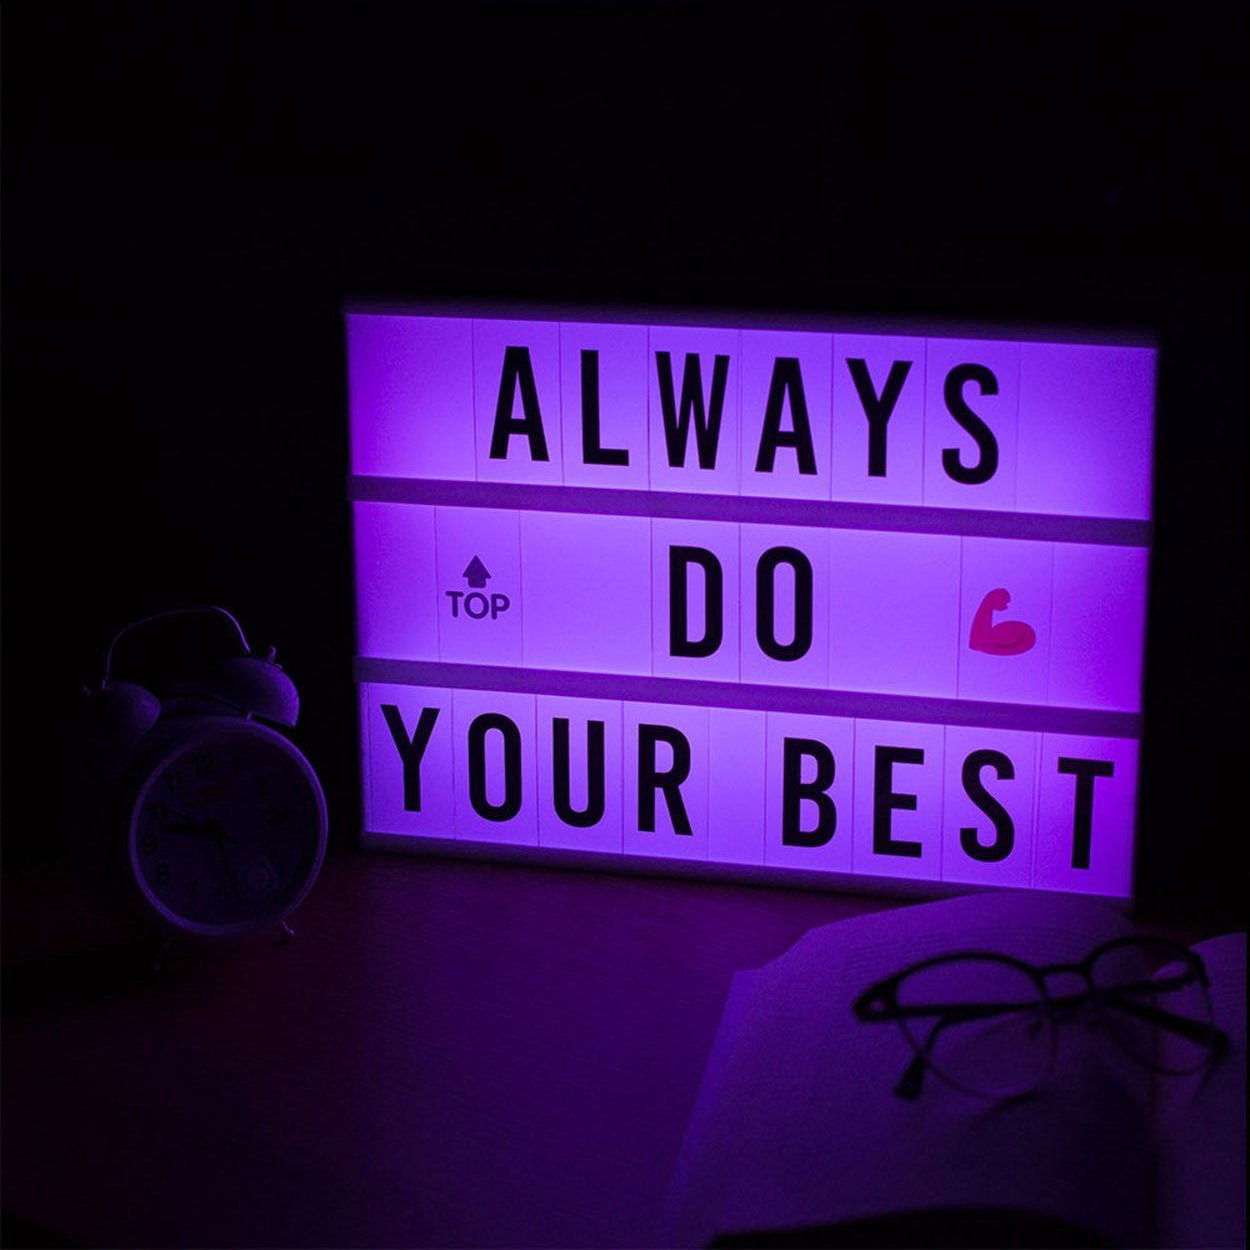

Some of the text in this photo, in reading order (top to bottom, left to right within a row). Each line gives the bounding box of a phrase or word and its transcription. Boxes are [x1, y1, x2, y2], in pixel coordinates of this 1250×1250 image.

[490, 346, 998, 484] ALWAYS
[446, 591, 510, 620] TOP
[670, 546, 812, 661] DO
[381, 705, 1114, 870] YOUR BEST
